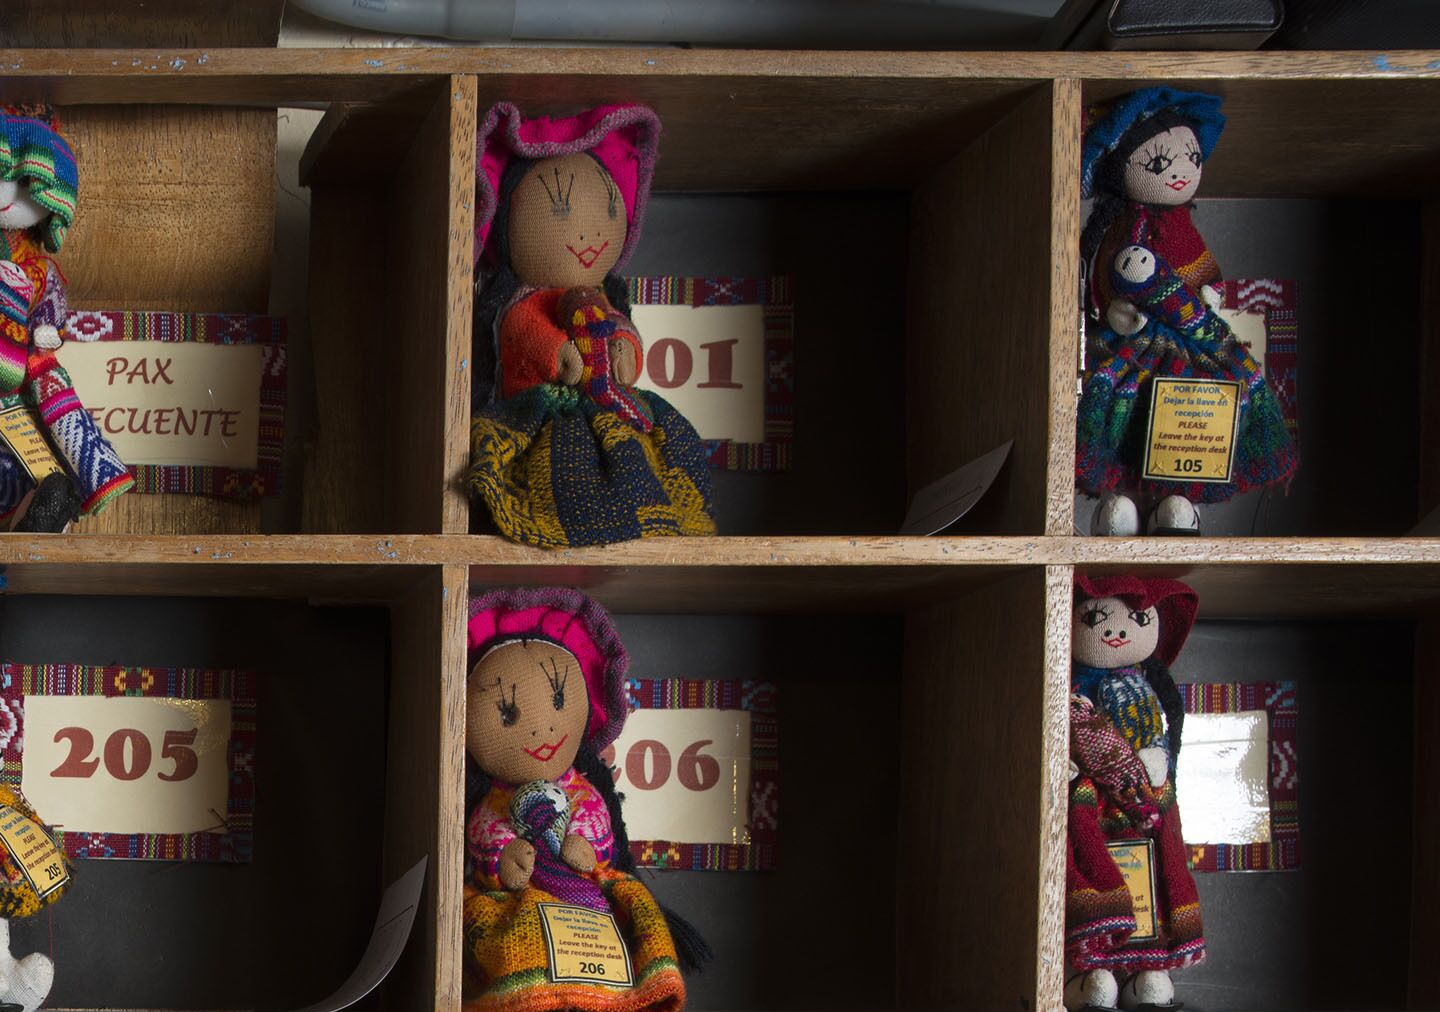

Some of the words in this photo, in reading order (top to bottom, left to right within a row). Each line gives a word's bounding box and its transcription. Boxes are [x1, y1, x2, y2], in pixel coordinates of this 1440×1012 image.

[646, 338, 743, 389] 01
[106, 357, 174, 385] PAX
[1164, 397, 1184, 405] Dejar
[1175, 410, 1214, 418] recepción
[86, 407, 240, 437] CUENTE
[1178, 421, 1208, 429] PLEASE
[1159, 432, 1181, 440] Leave
[1199, 434, 1214, 443] key
[1168, 444, 1207, 453] reception
[1209, 446, 1227, 454] desk
[1174, 459, 1202, 472] 105
[50, 727, 198, 782] 205
[45, 863, 61, 880] 205
[571, 950, 604, 958] reception
[579, 962, 605, 975] 206
